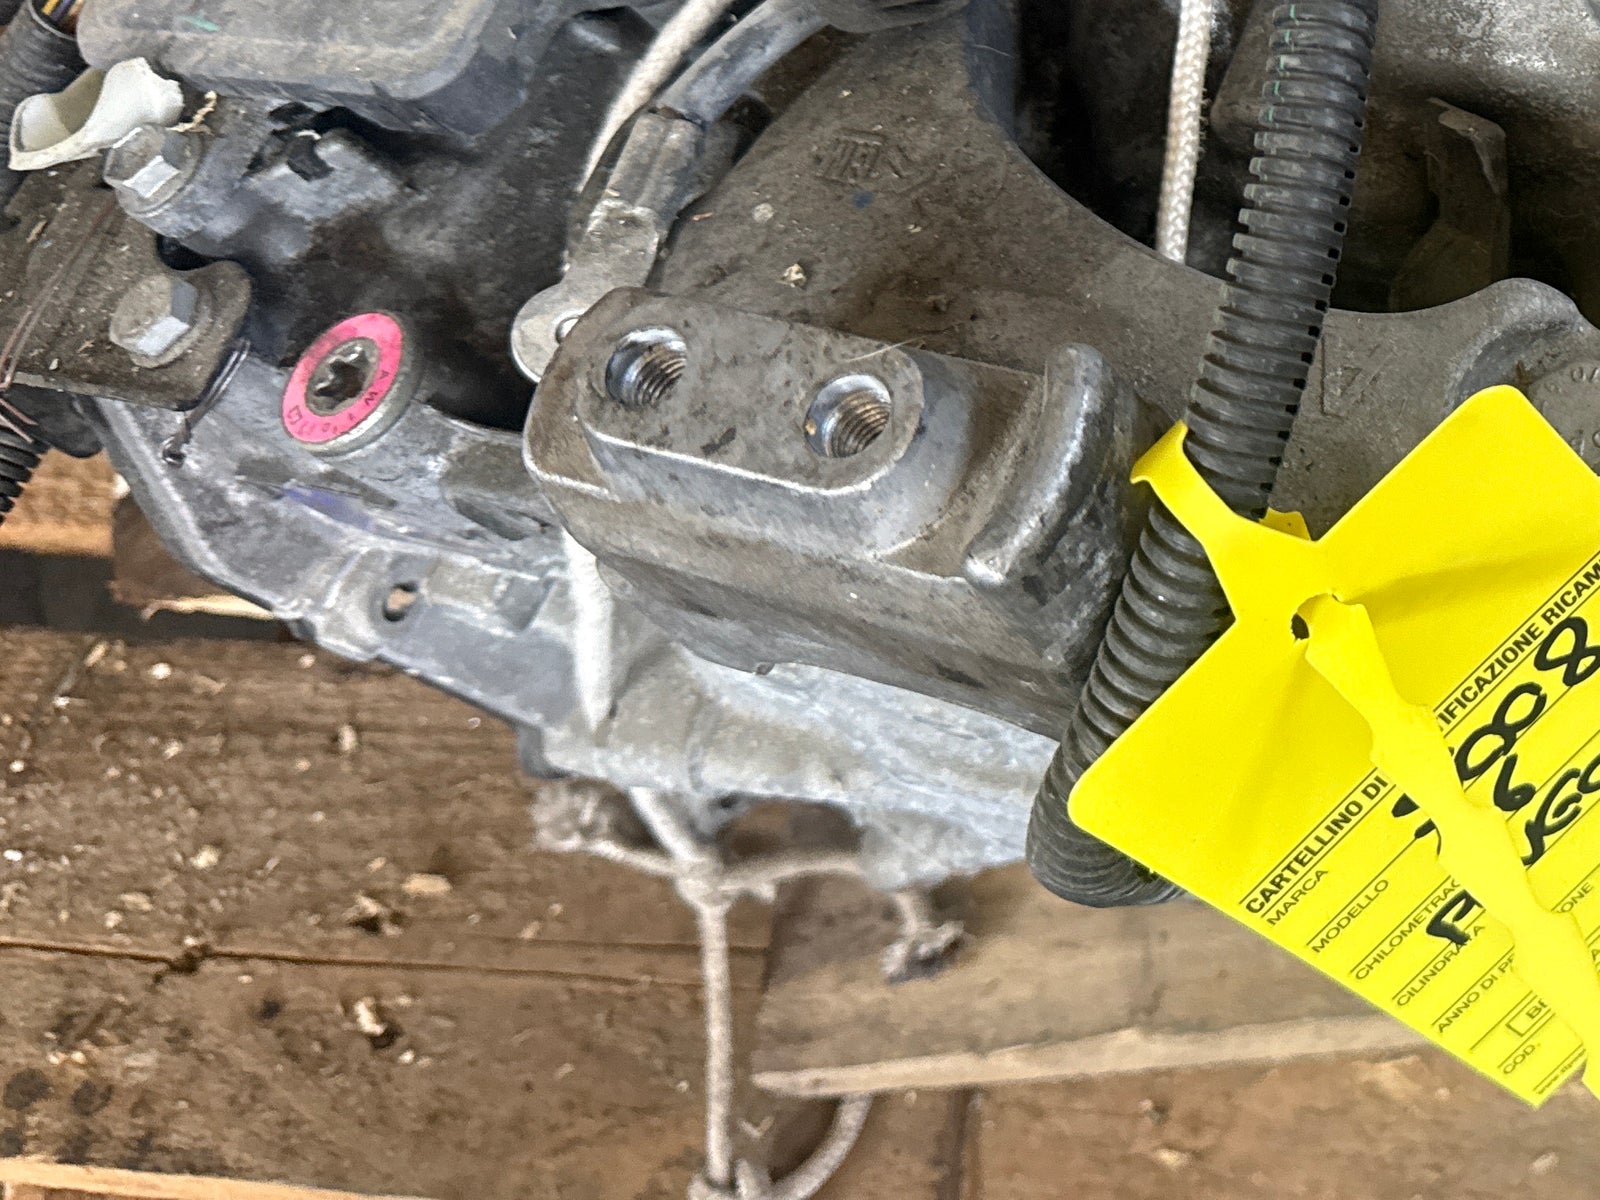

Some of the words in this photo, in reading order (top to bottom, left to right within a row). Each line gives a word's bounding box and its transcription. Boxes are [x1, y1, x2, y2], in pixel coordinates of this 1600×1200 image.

[1246, 801, 1362, 912] CARTELLINO
[1361, 775, 1387, 799] DI
[1266, 870, 1327, 925] MARCA
[1311, 879, 1388, 952] MODELLO
[1438, 991, 1479, 1033] ANNO
[1479, 972, 1499, 993] DI
[1502, 1042, 1542, 1075] COD.
